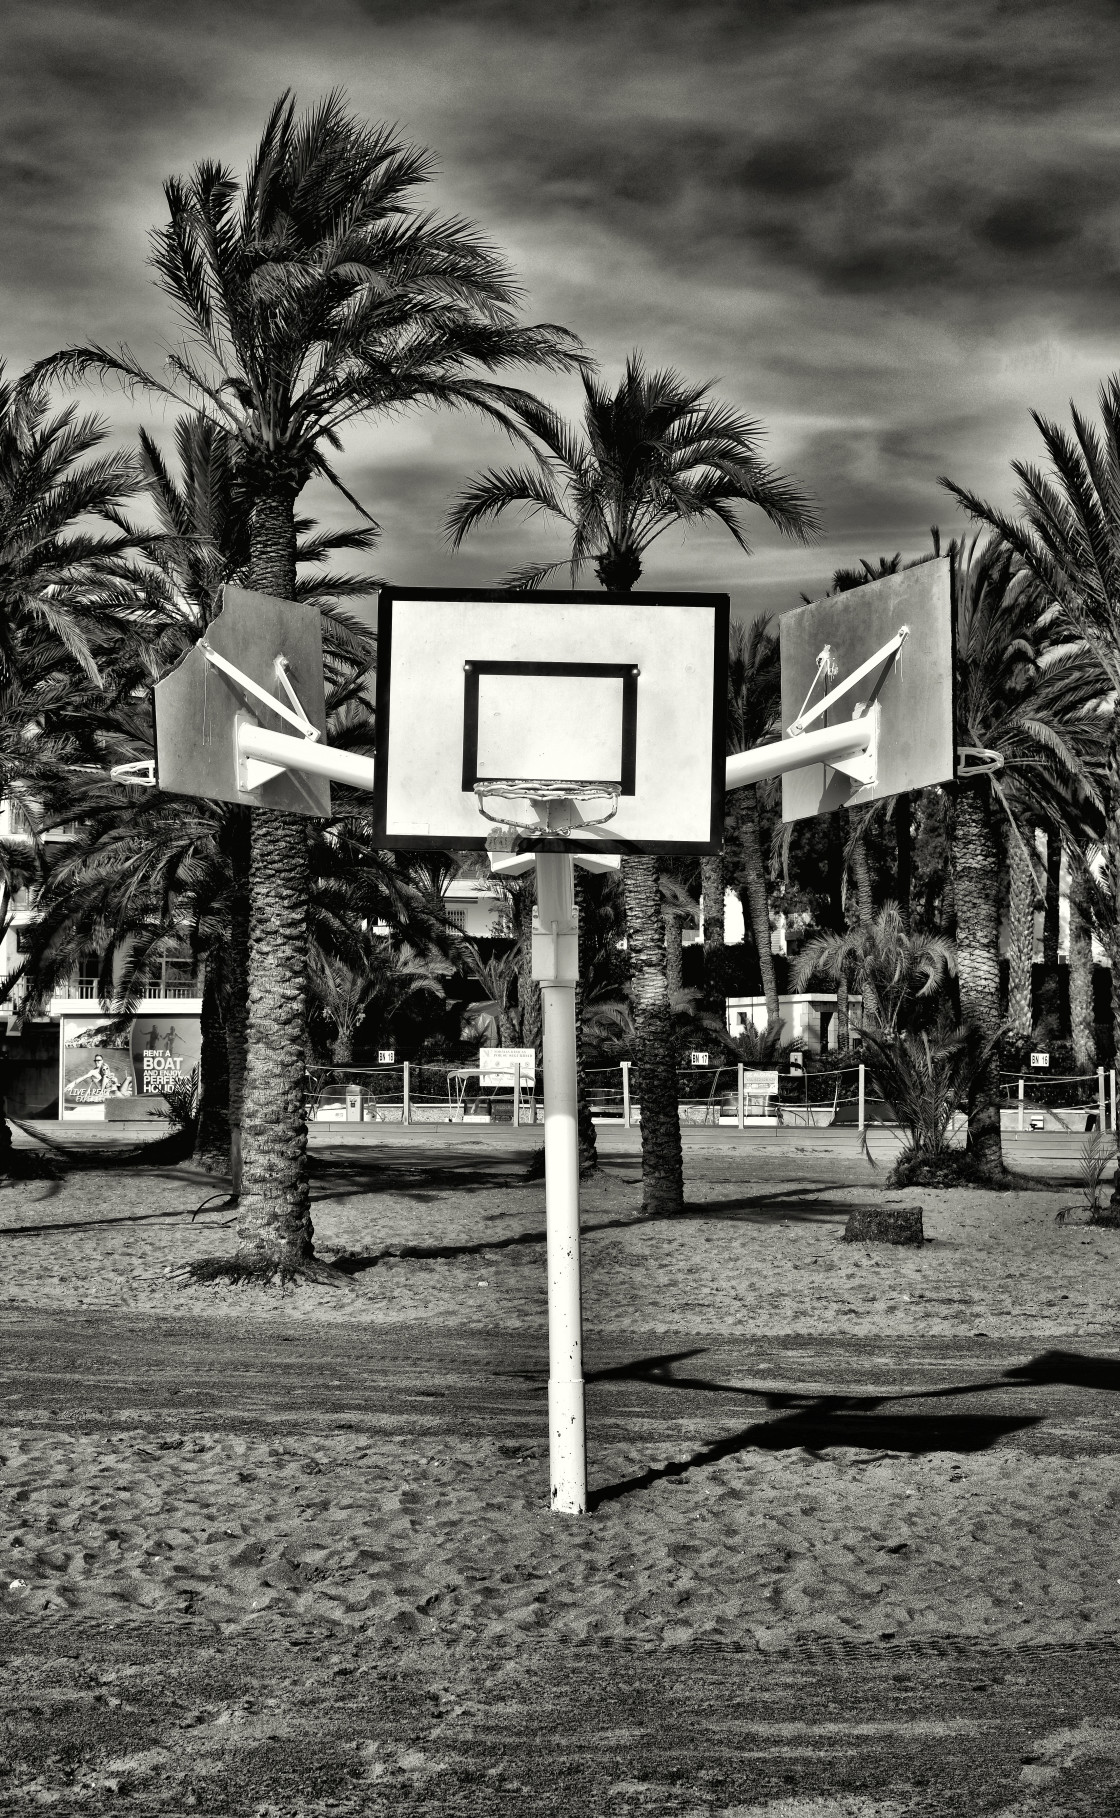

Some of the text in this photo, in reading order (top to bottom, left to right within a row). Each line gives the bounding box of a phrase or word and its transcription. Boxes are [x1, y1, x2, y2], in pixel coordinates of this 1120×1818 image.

[143, 1057, 184, 1070] BOAT
[702, 1054, 708, 1064] 17
[1032, 1054, 1048, 1065] BN 16
[143, 1075, 190, 1085] PERFE
[69, 1088, 87, 1096] LIVE
